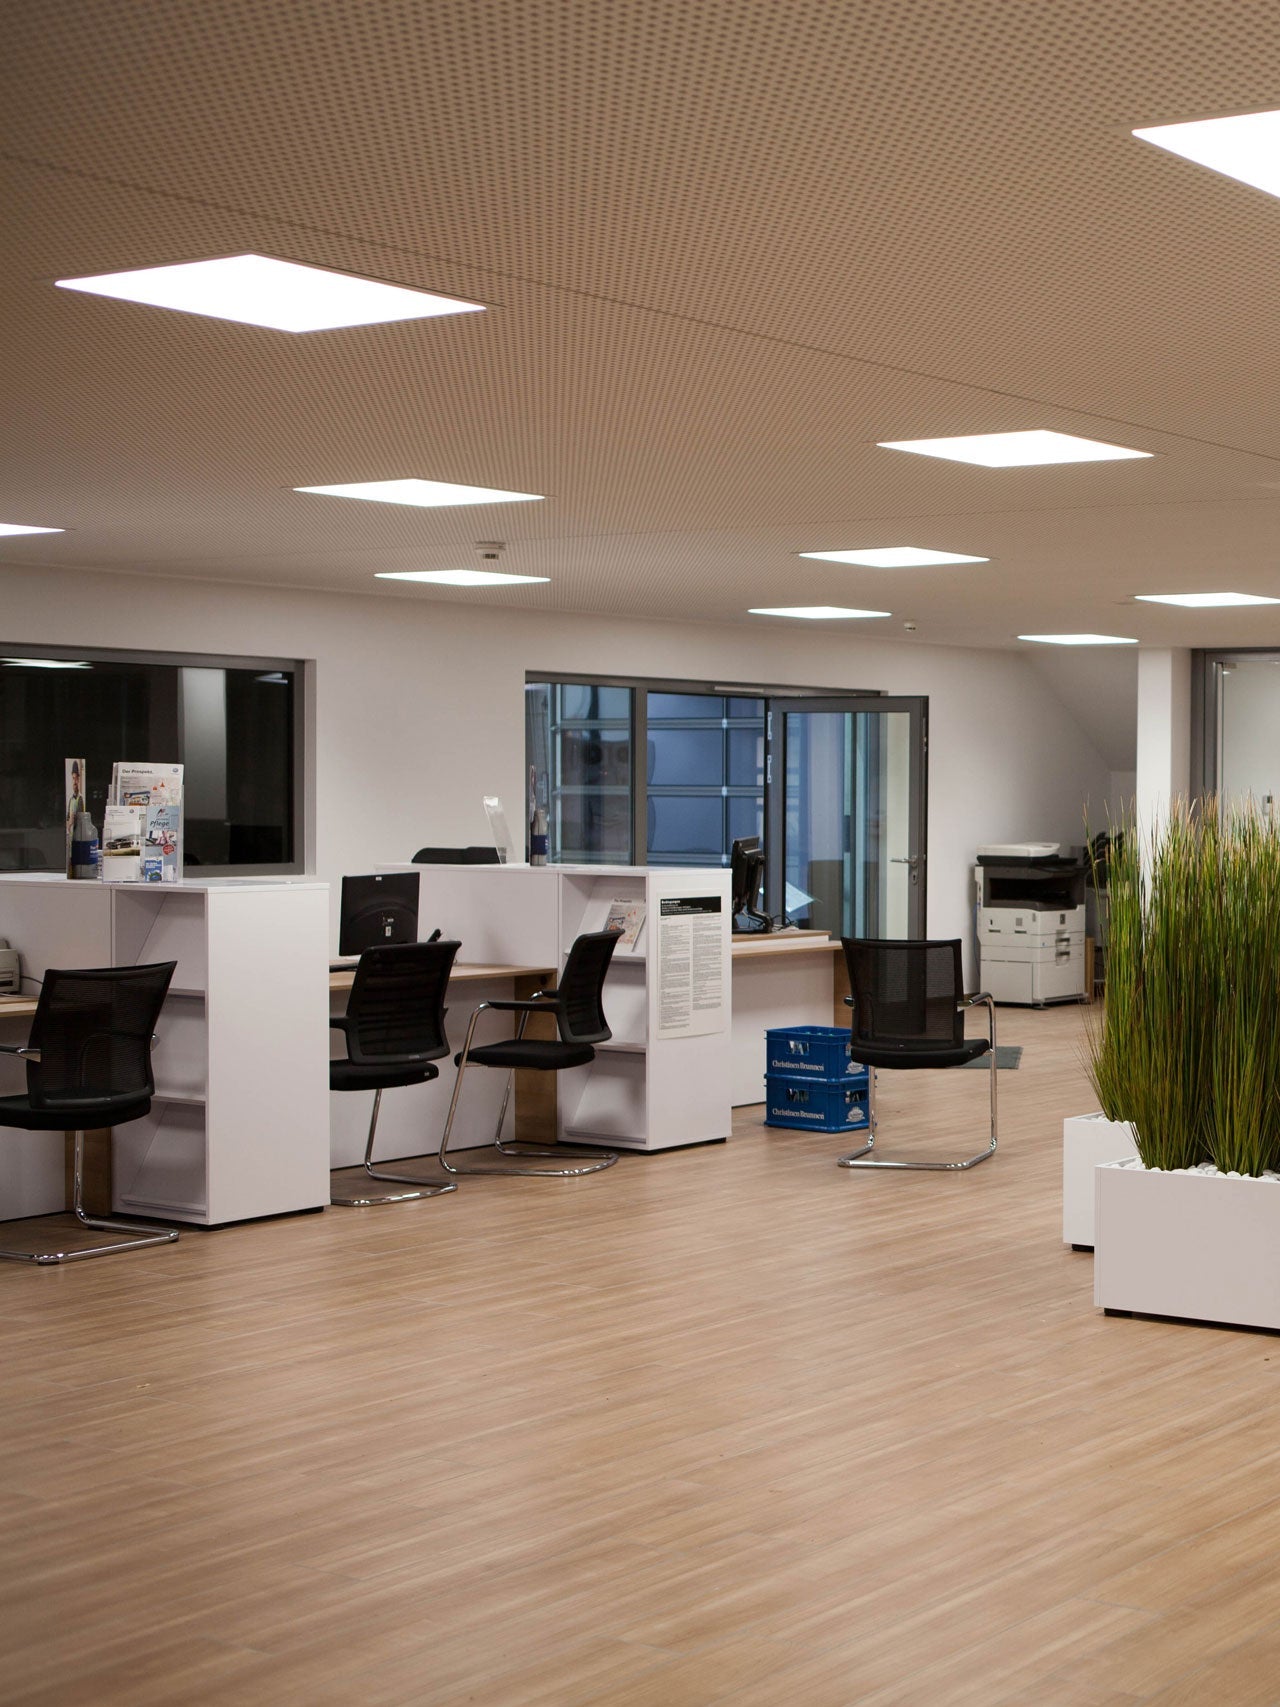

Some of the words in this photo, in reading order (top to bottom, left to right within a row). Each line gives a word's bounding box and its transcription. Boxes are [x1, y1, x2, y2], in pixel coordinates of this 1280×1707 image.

[150, 820, 170, 828] Pflege
[772, 1060, 800, 1069] Christinen
[800, 1062, 825, 1071] Brunnen
[772, 1108, 800, 1117] Christinen
[800, 1110, 825, 1120] Brunnen
